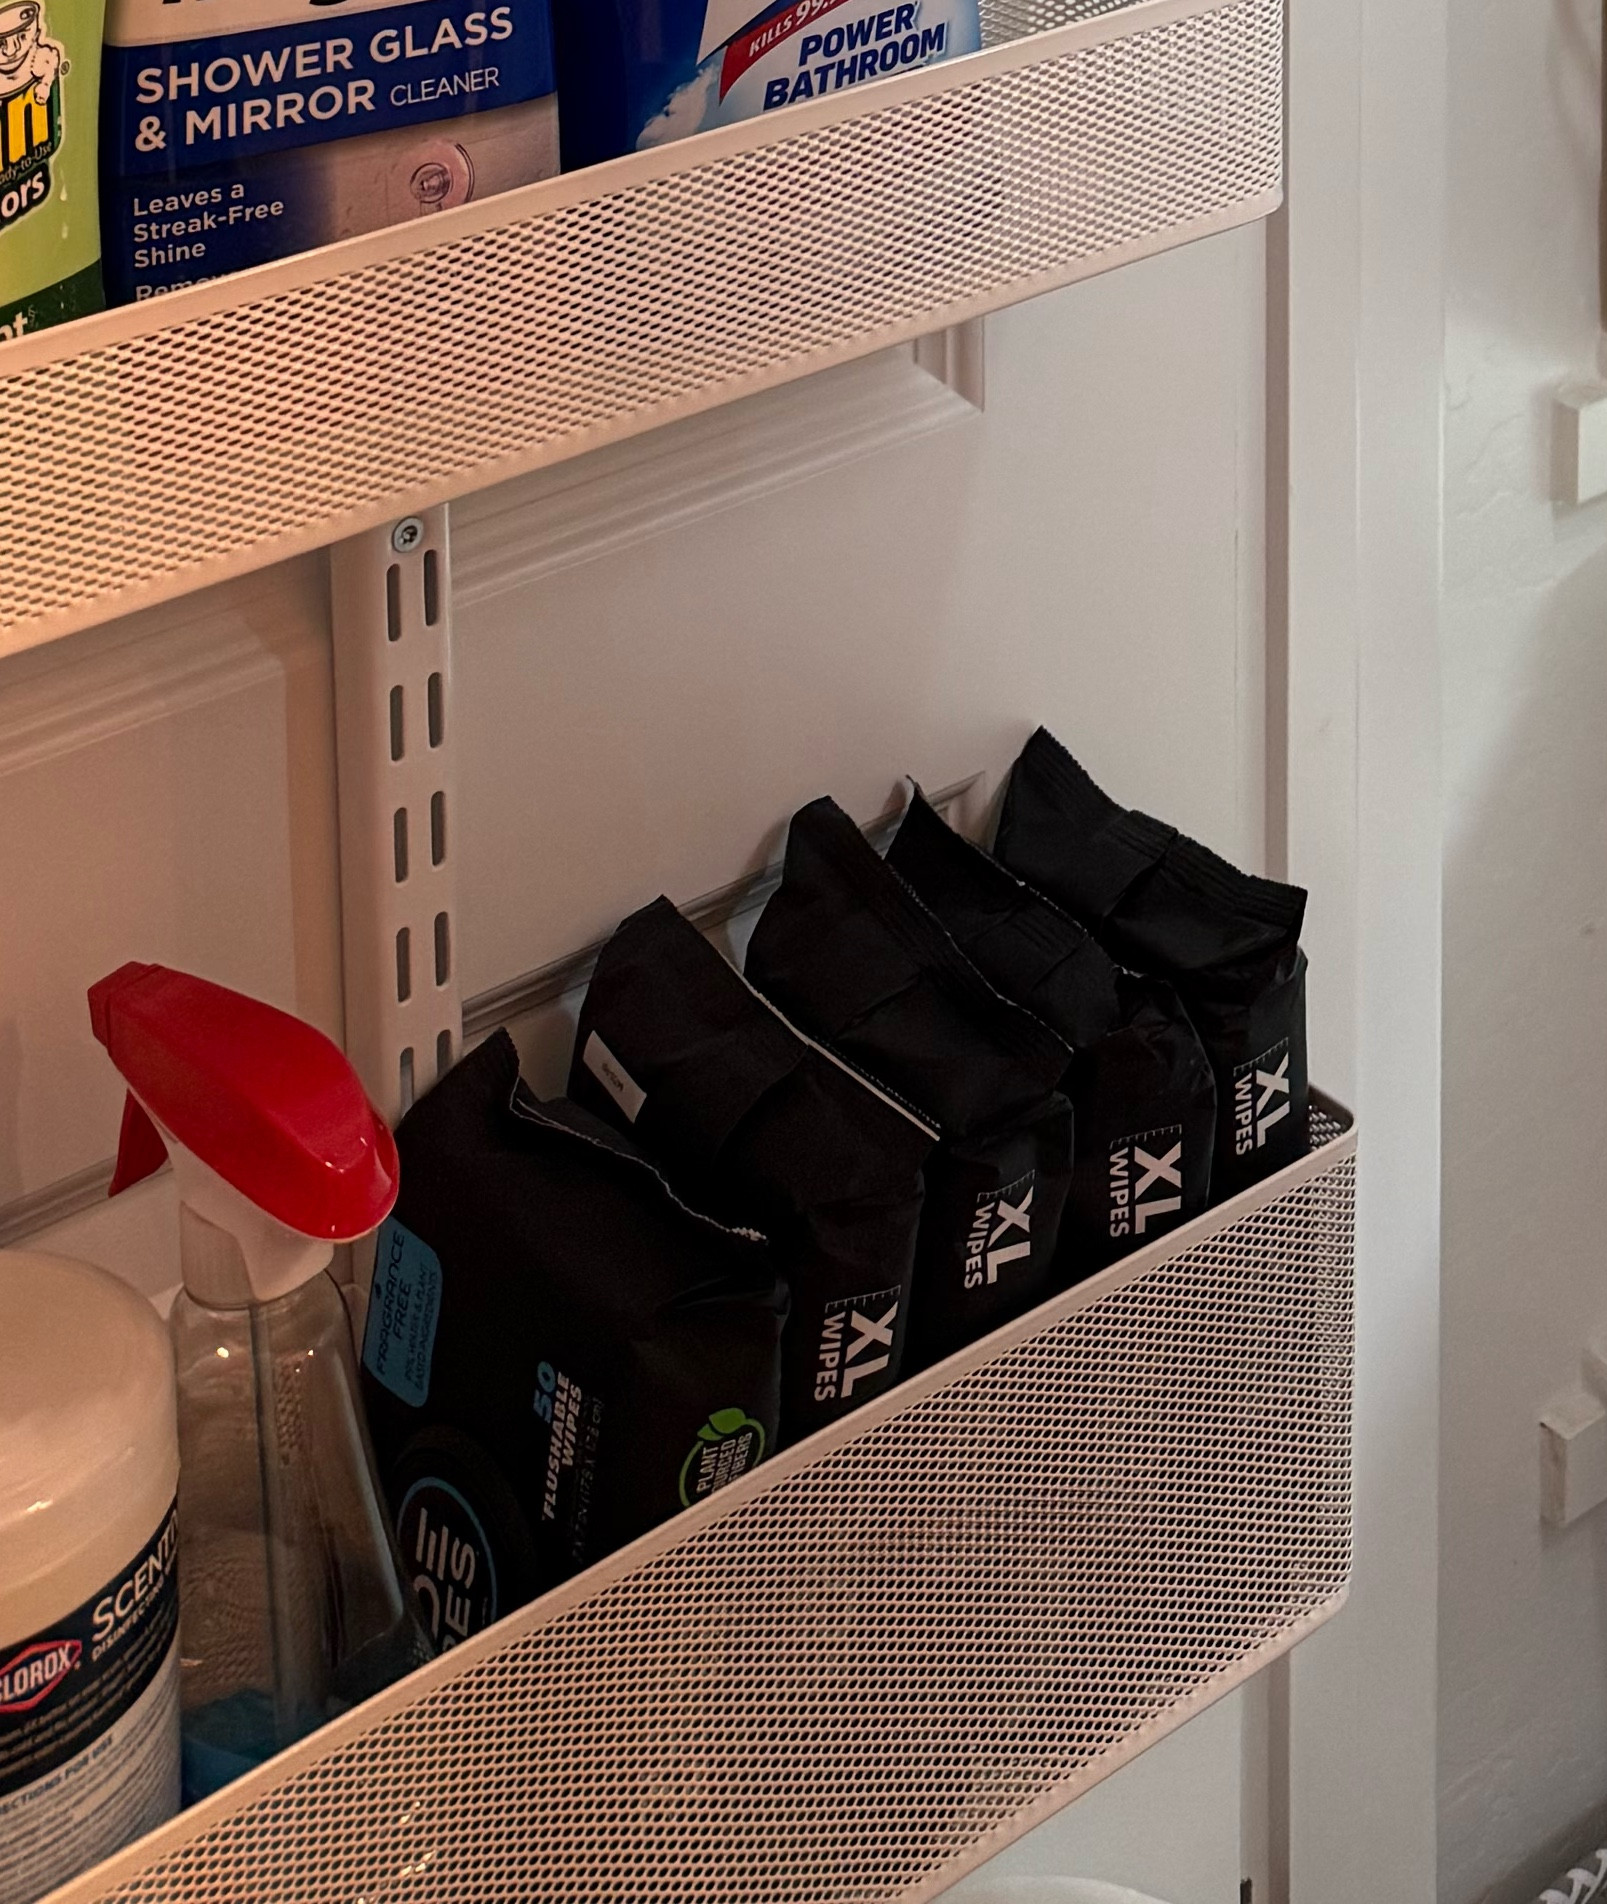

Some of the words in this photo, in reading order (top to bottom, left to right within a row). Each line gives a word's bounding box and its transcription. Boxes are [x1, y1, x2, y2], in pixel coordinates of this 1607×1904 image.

[136, 37, 354, 104] SHOWER
[370, 6, 513, 64] GLASS
[749, 14, 793, 57] KILLS
[763, 21, 945, 111] BATHROOM
[798, 3, 917, 67] POWER
[134, 116, 167, 152] &
[186, 79, 376, 145] MIRROR
[390, 66, 500, 108] CLEANER
[1, 171, 45, 218] ors
[133, 187, 222, 217] Leaves
[230, 183, 245, 199] a
[133, 200, 285, 243] Streak-Free
[133, 242, 206, 268] Shine
[1235, 1072, 1253, 1155] WIPES
[1256, 1052, 1290, 1148] XL
[1109, 1146, 1129, 1237] WIPES
[1134, 1140, 1182, 1234] XL
[964, 1192, 995, 1289] WIPES
[987, 1186, 1034, 1284] XL
[376, 1229, 405, 1376] FRAGRANCE
[392, 1281, 411, 1341] FREE
[814, 1311, 846, 1401] WIPES
[840, 1301, 898, 1397] XL
[533, 1360, 556, 1423] 50
[562, 1383, 582, 1467] WIPES
[696, 1445, 719, 1494] PLANT
[0, 1773, 62, 1815] ECTIONS
